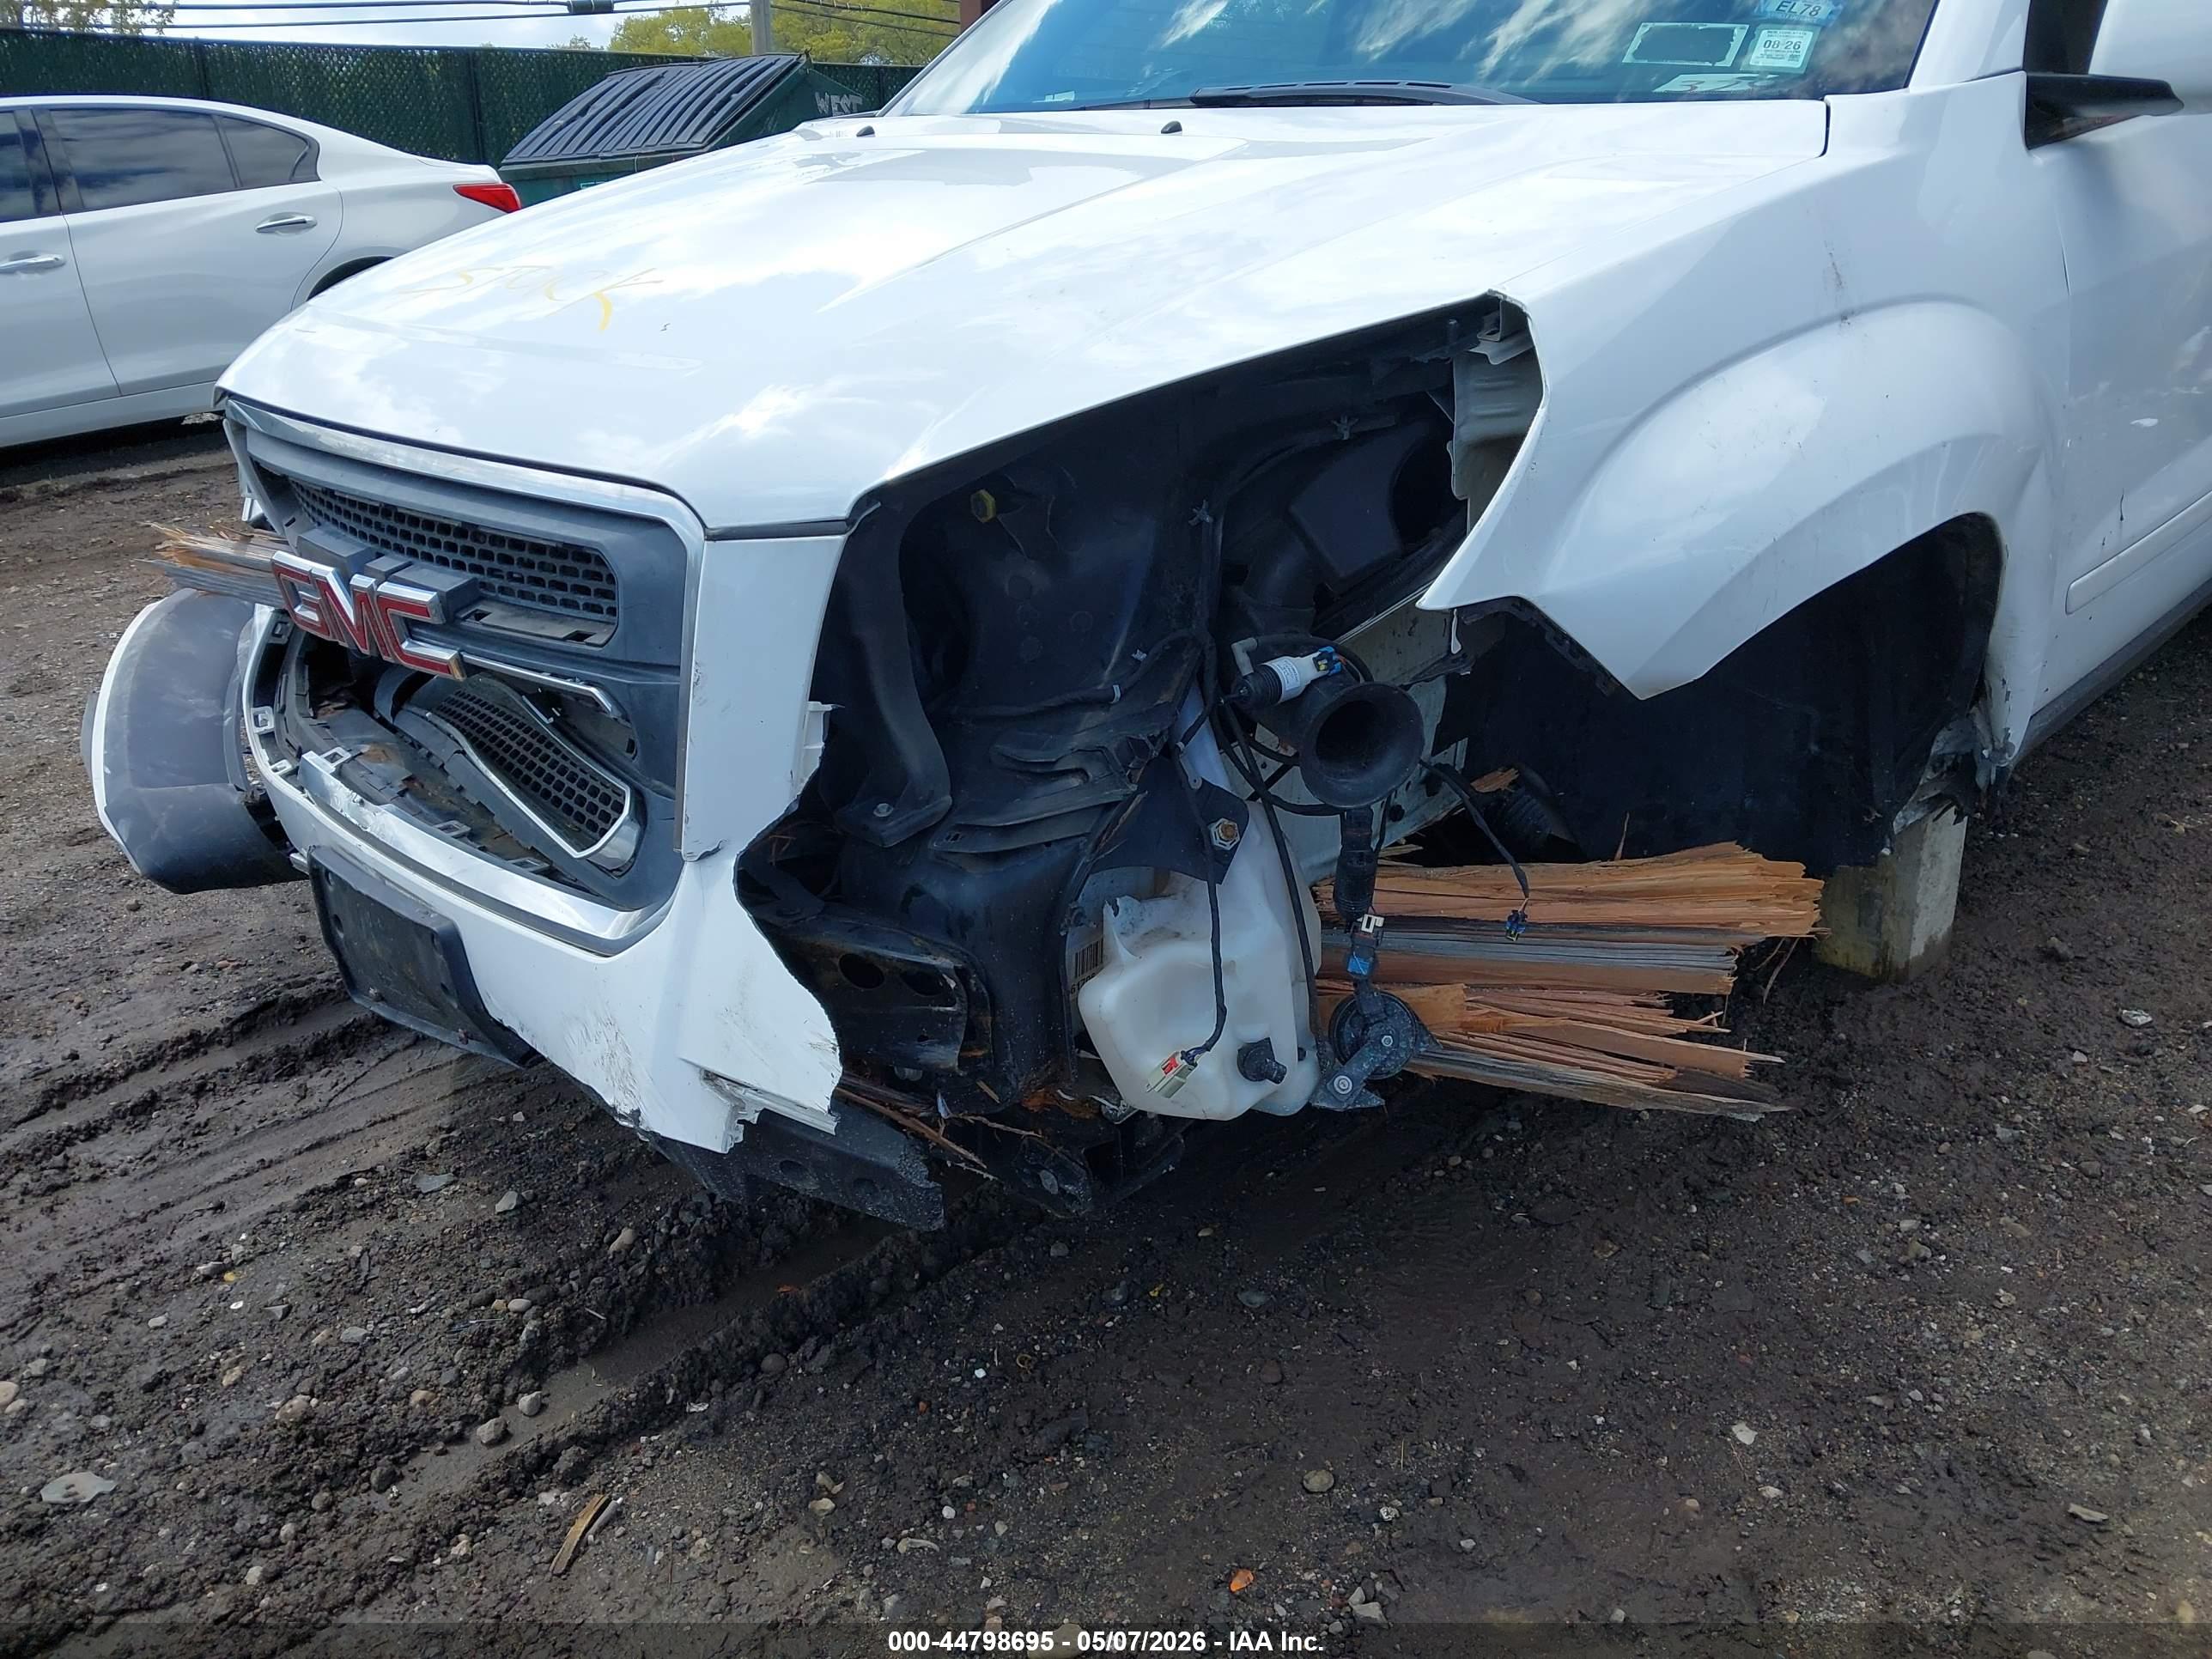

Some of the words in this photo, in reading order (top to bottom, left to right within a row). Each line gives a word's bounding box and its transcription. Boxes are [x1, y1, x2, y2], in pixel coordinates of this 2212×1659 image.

[1775, 1, 1821, 16] EL78
[1763, 40, 1781, 49] 08
[1784, 40, 1802, 50] 26
[815, 92, 863, 117] WEST
[271, 550, 465, 681] GMC
